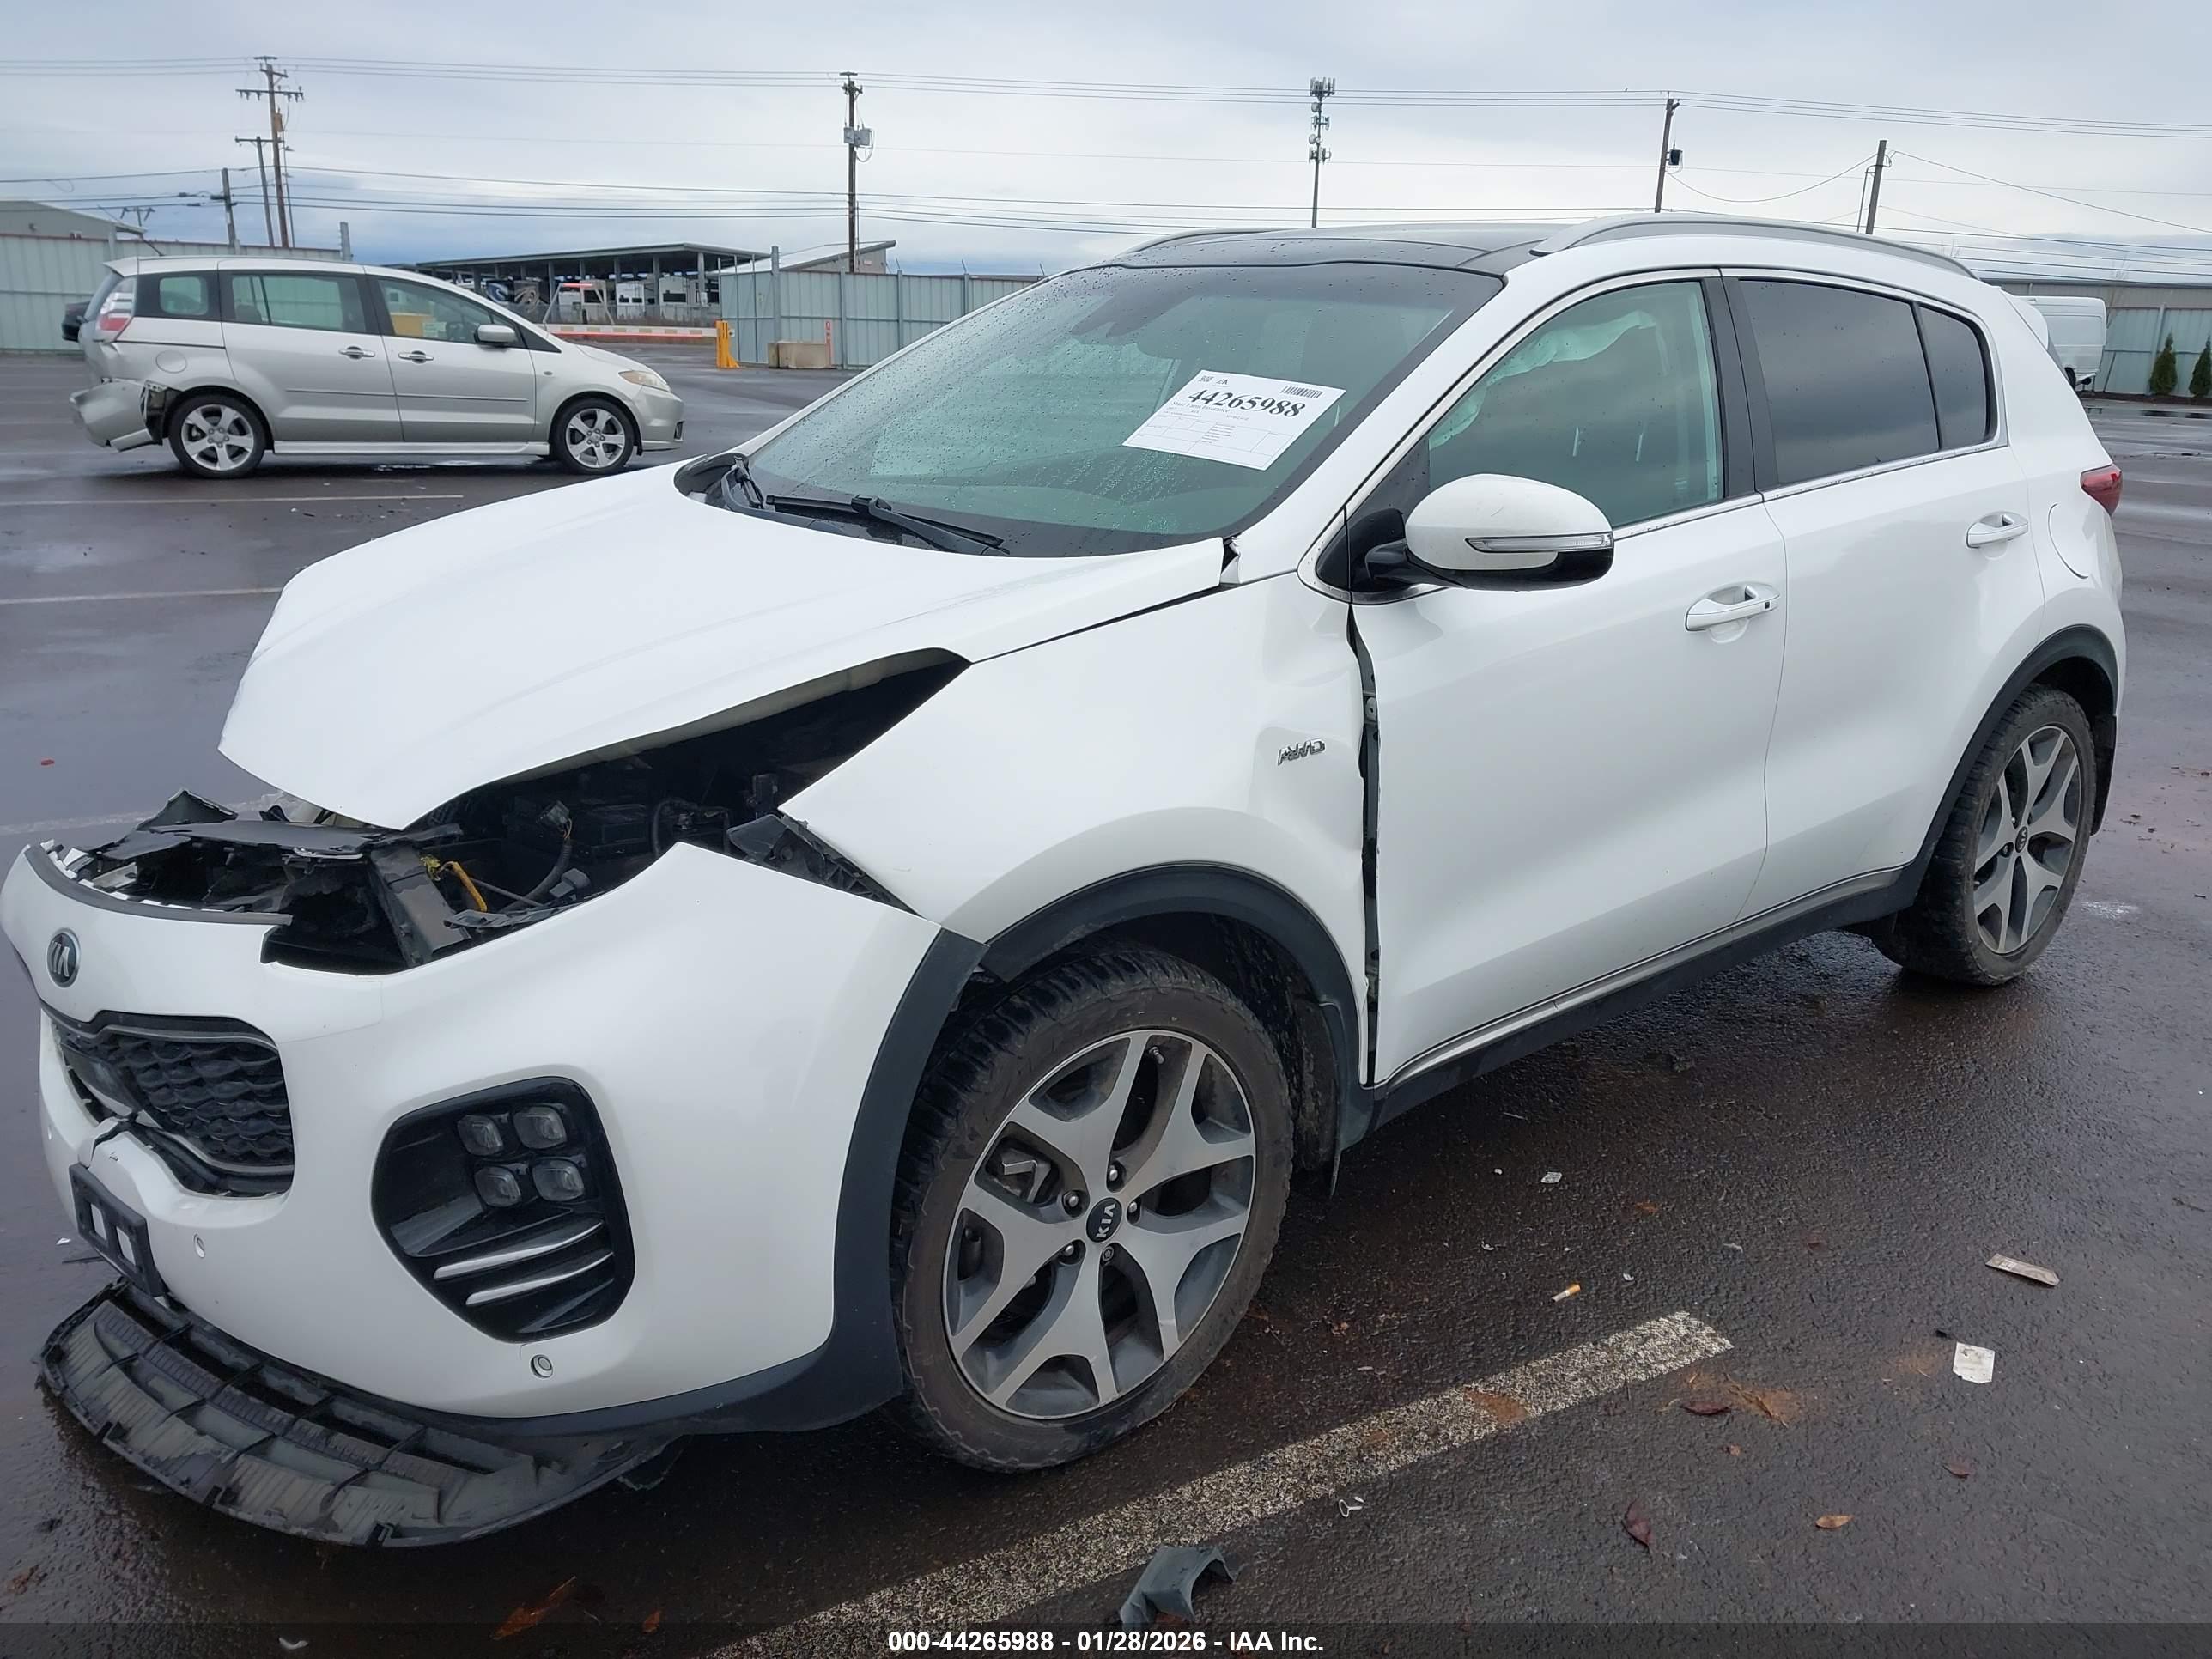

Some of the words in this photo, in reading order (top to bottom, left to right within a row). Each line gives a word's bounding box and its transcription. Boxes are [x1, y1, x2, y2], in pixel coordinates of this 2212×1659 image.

[1188, 389, 1306, 417] 44265988
[1277, 738, 1326, 766] AWD
[1095, 1203, 1116, 1238] KIA
